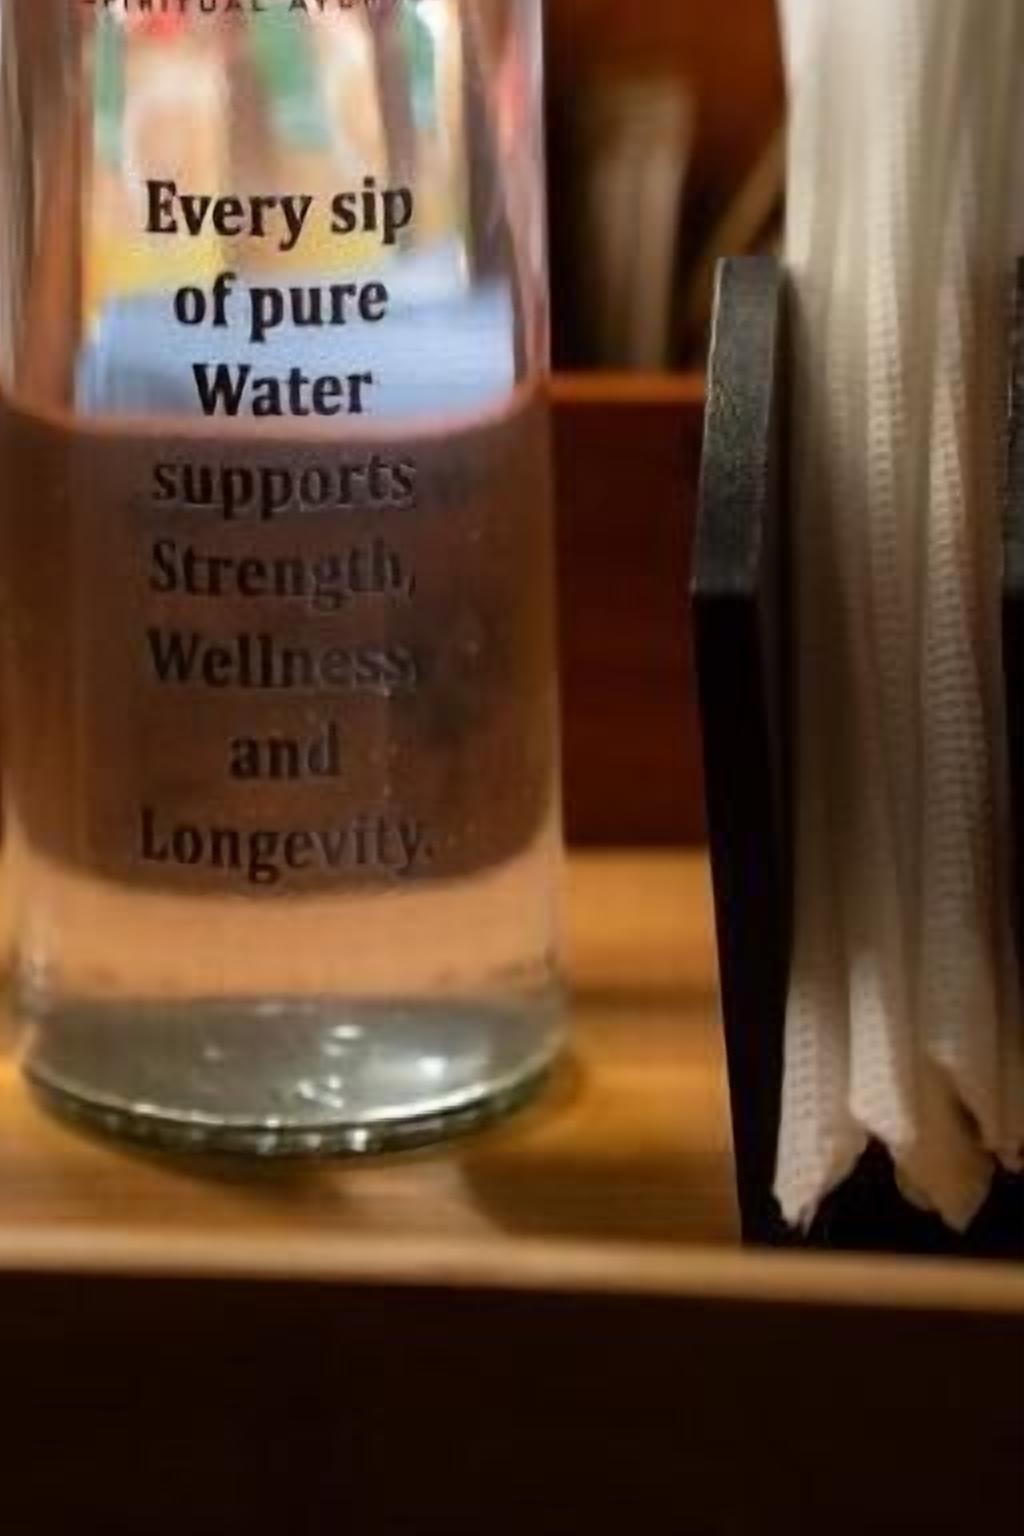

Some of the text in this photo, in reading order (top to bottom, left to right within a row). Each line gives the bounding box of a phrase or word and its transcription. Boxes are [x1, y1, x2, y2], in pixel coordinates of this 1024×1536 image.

[144, 176, 414, 252] Every sip
[173, 271, 389, 343] of pure
[191, 363, 374, 418] Water
[150, 456, 417, 521] supports
[148, 537, 417, 612] Strength,
[230, 720, 341, 781] and
[139, 806, 435, 885] Longevity.
